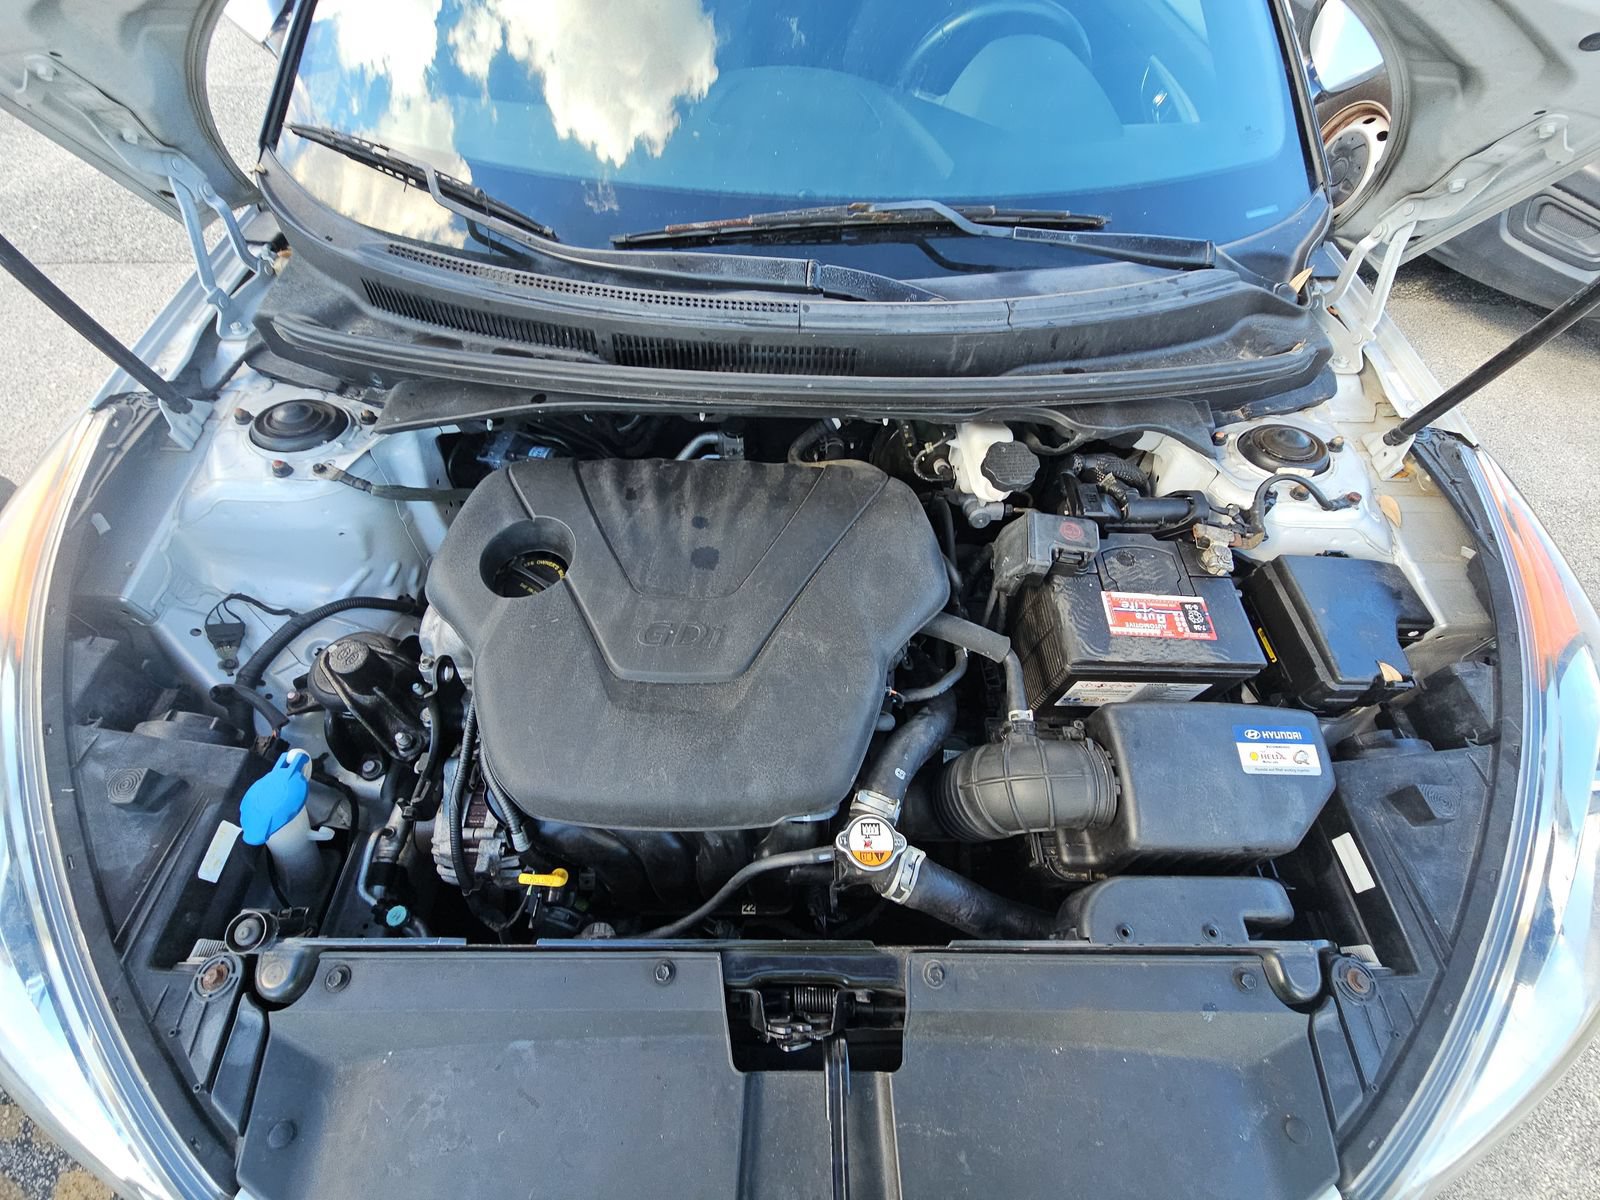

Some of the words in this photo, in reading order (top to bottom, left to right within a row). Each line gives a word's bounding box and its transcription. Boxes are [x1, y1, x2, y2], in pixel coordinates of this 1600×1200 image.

[1120, 600, 1147, 611] Life
[1135, 612, 1166, 624] Auto
[1261, 731, 1302, 740] HYUNDAI
